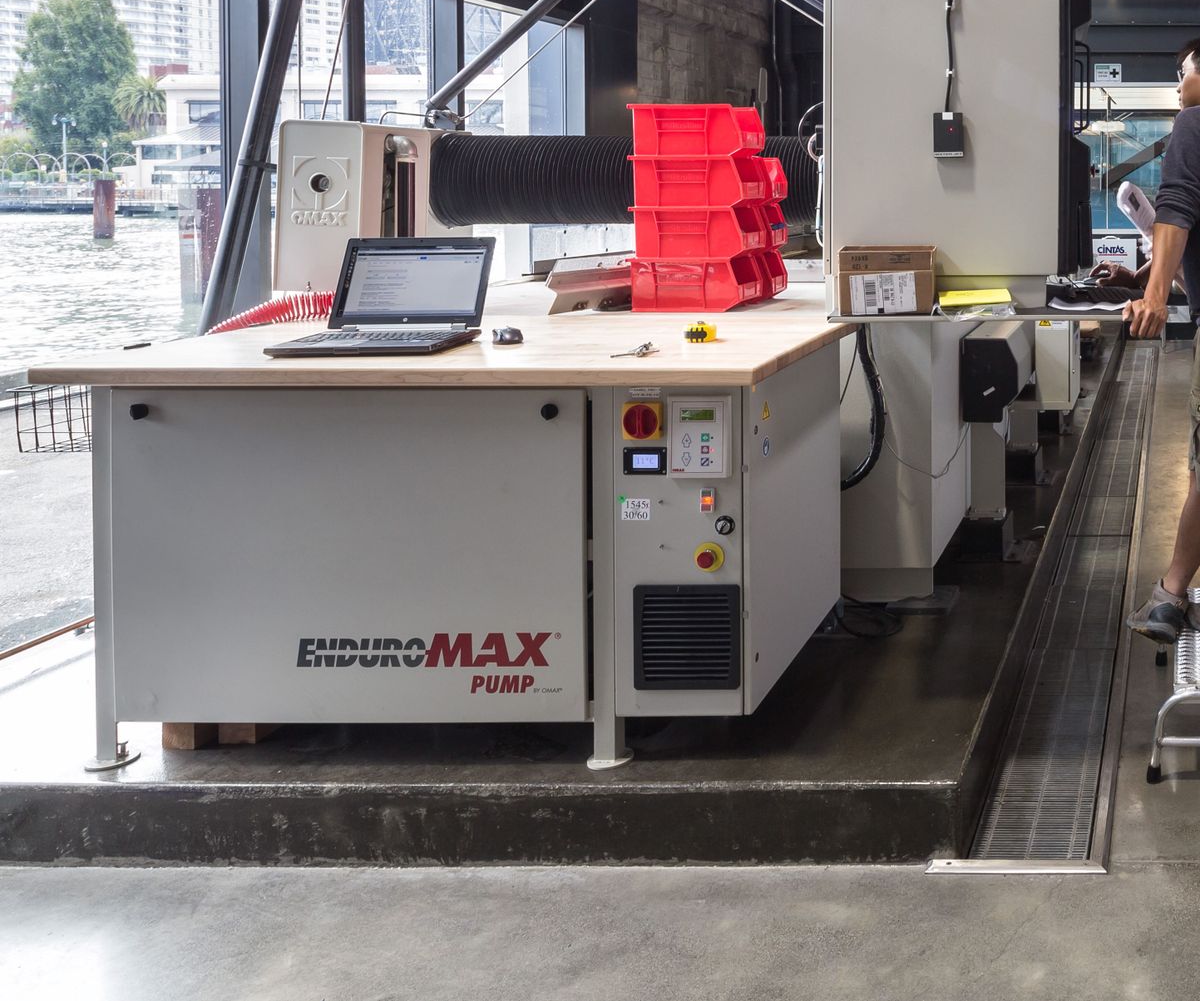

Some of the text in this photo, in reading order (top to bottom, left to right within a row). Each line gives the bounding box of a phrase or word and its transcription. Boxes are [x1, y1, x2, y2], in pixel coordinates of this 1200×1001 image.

[291, 210, 347, 226] OMAX
[1097, 244, 1125, 254] CINTAS
[623, 511, 648, 520] 30/60
[470, 675, 535, 693] PUMP
